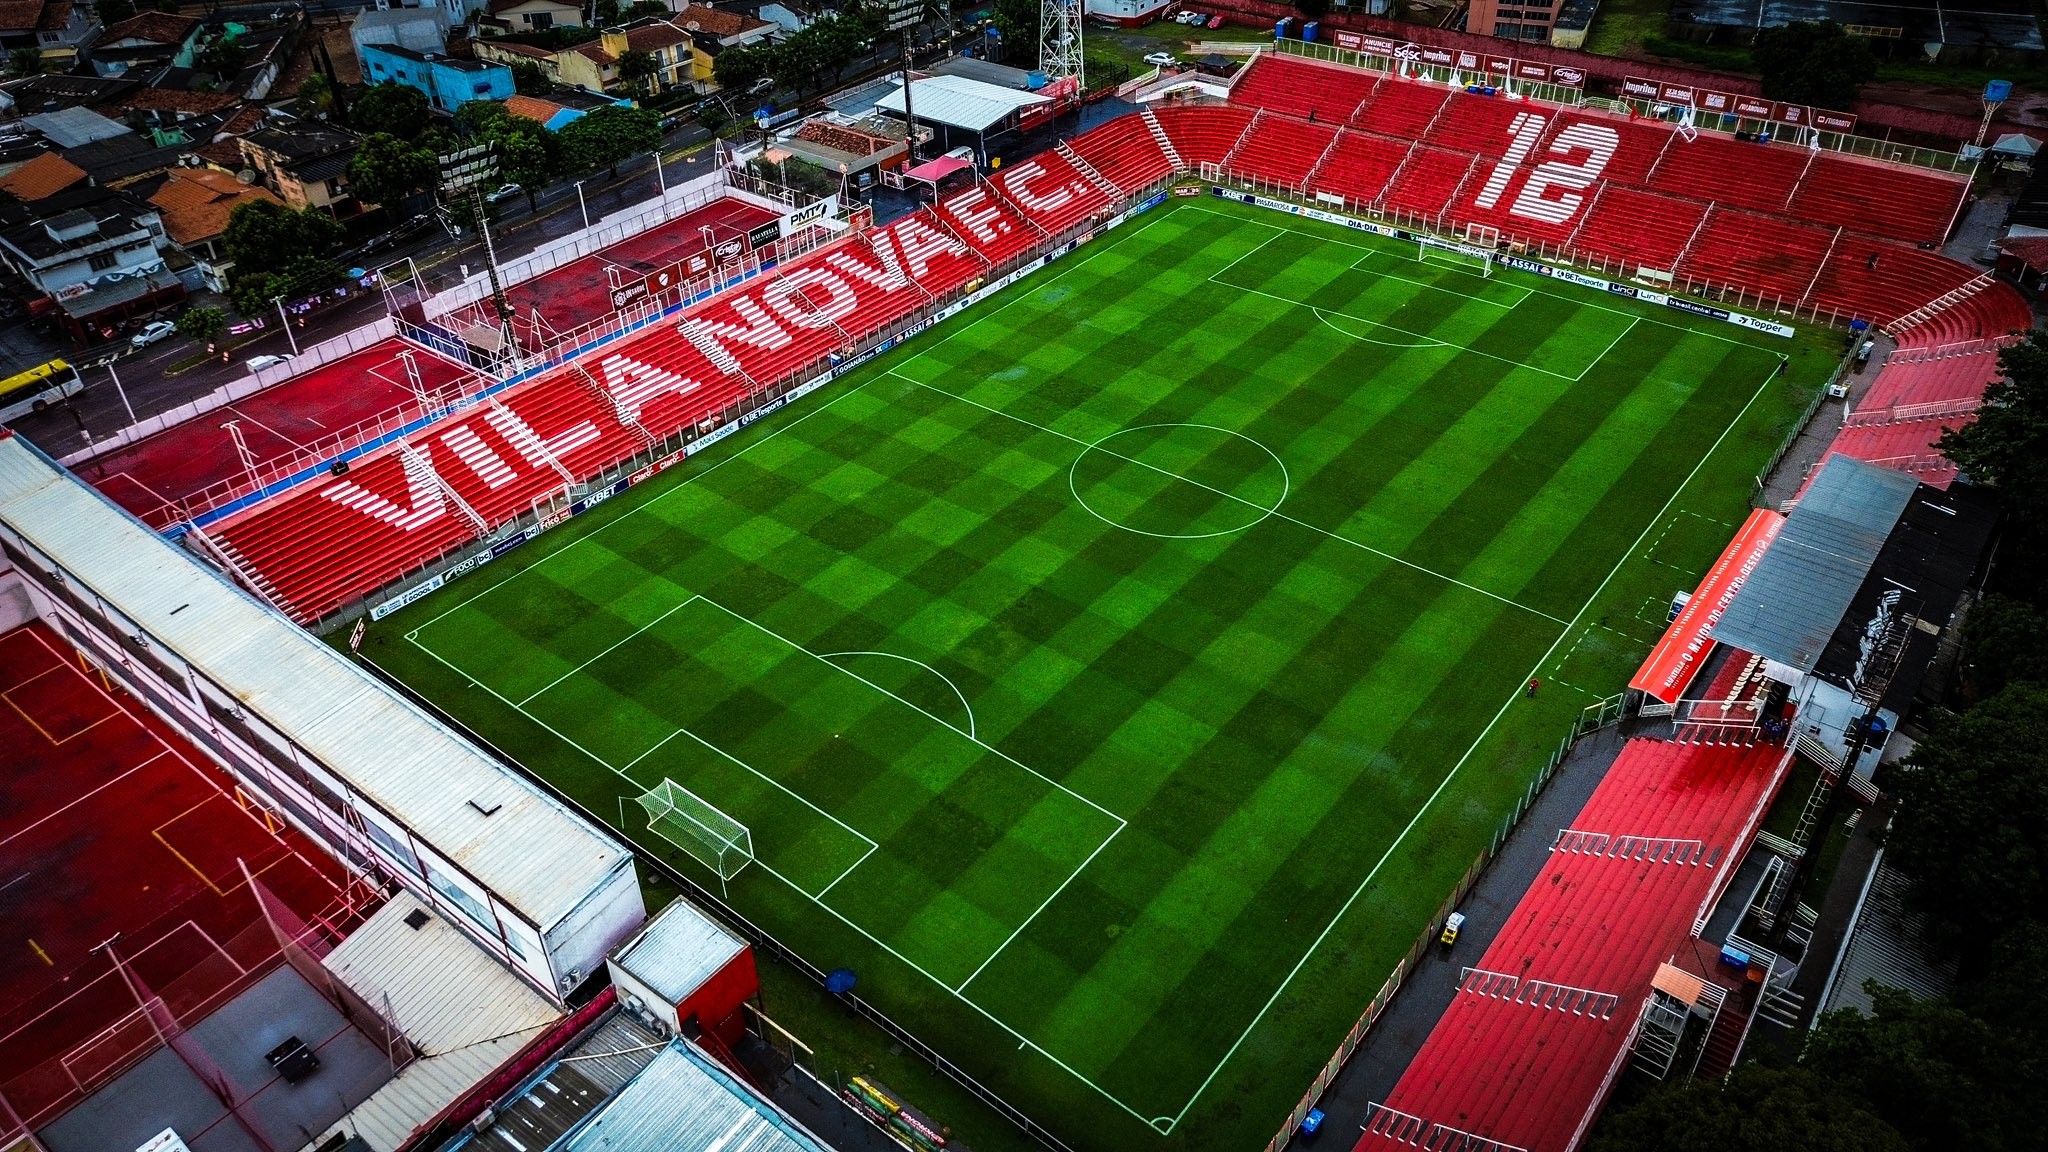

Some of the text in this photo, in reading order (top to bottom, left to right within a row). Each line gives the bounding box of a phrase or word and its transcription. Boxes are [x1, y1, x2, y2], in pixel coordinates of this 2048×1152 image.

[1364, 38, 1392, 49] ANUNCIE
[1394, 48, 1421, 61] Sesc
[1423, 50, 1451, 63] Imprilux
[1625, 82, 1657, 96] Imprilux
[1475, 112, 1620, 224] 12
[1221, 189, 1247, 201] 1XBET
[1256, 198, 1290, 212] PASTAROSA
[1511, 256, 1539, 272] ASSAÍ
[1565, 272, 1604, 289] BETesporte
[904, 321, 925, 340] ASSAÍ
[1750, 317, 1783, 333] Topper
[839, 352, 866, 374] GOIANÃO
[319, 353, 702, 532] VILA
[677, 216, 968, 376] NOVA
[749, 398, 784, 422] BETesporte
[699, 423, 734, 447] Mais Saúde
[659, 456, 678, 470] Claro
[632, 469, 651, 484] Claro
[583, 485, 617, 509] 1XBET
[526, 525, 539, 539] bcj
[454, 559, 475, 575] FOCO
[478, 552, 493, 566] bcj
[409, 586, 432, 602] GOOOL
[1707, 608, 1723, 624] DO
[1687, 622, 1712, 654] MAIOR
[1681, 652, 1694, 662] O
[1663, 661, 1686, 688] RAFATELLA
